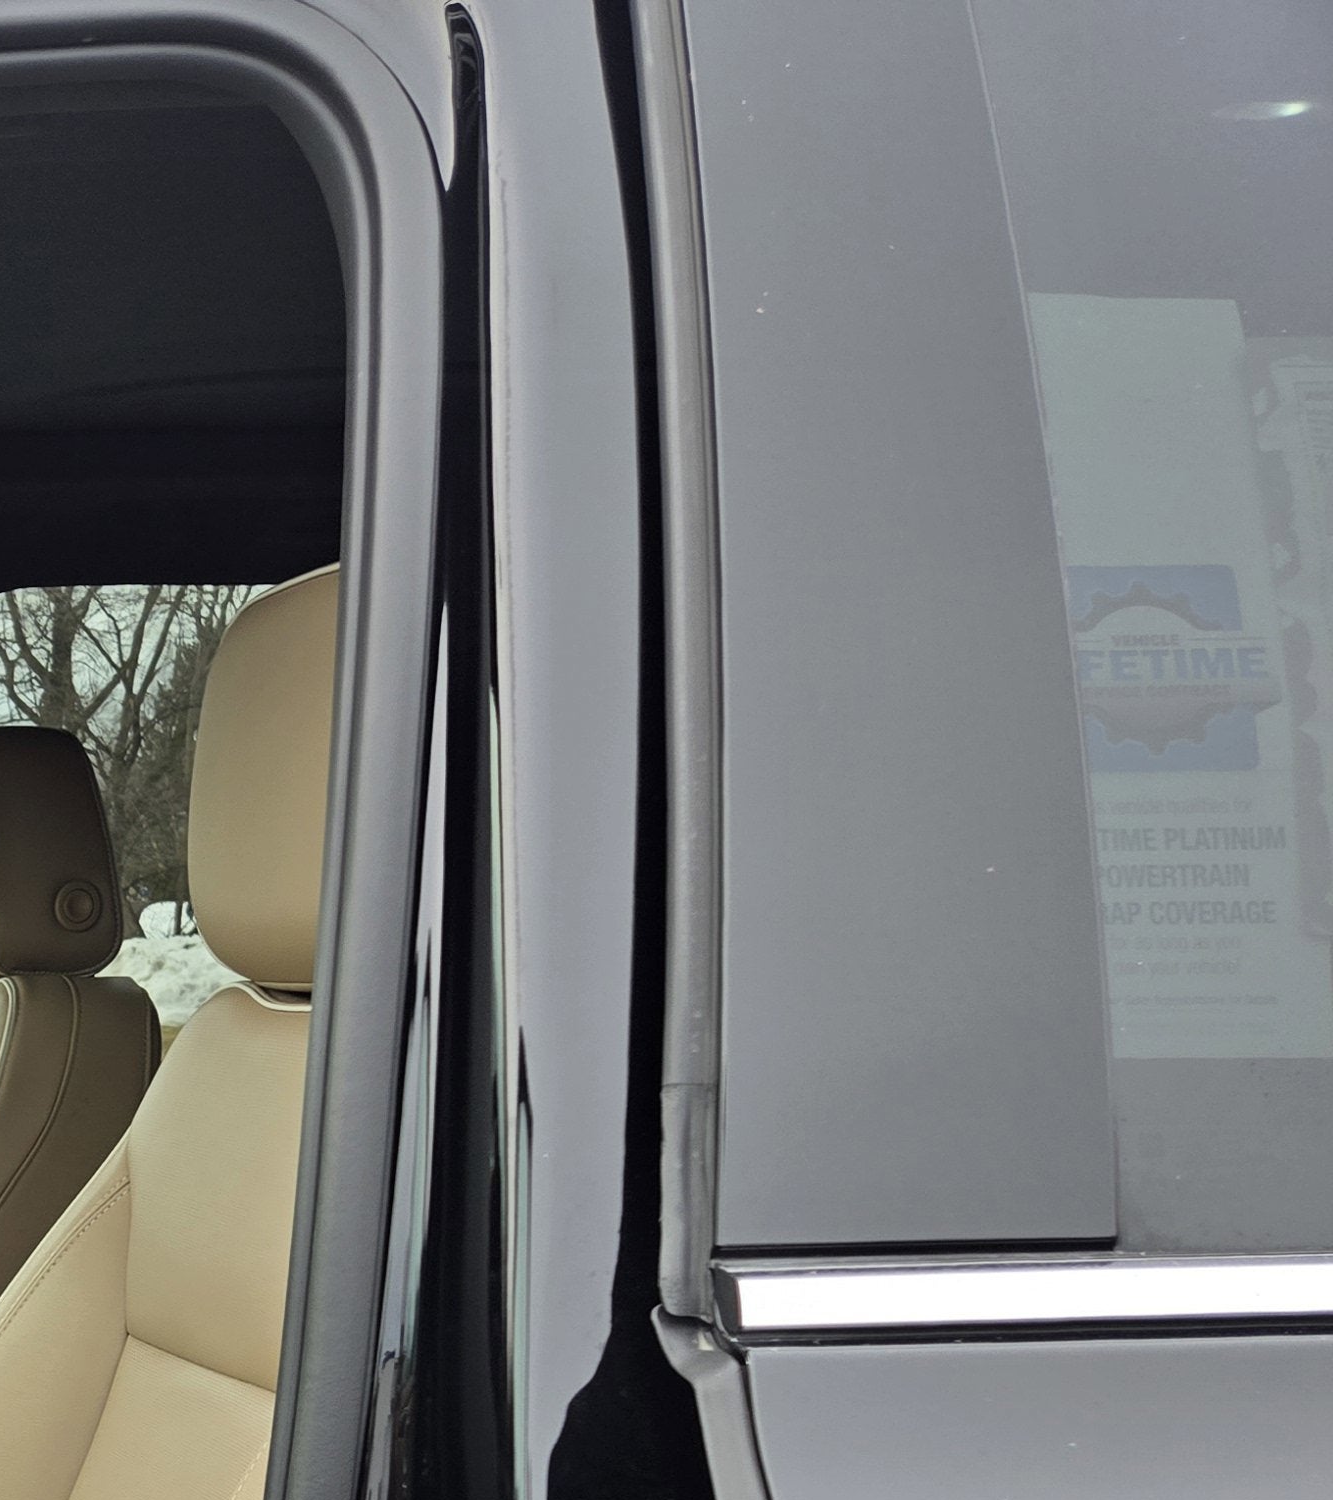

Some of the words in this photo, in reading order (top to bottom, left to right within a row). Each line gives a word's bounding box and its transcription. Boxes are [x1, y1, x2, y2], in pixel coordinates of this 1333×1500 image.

[1111, 634, 1179, 647] VEHICLE
[1076, 647, 1270, 681] FETIME
[1097, 828, 1157, 851] TIME
[1164, 826, 1286, 851] PLATINUM
[1149, 900, 1277, 925] COVERAGE
